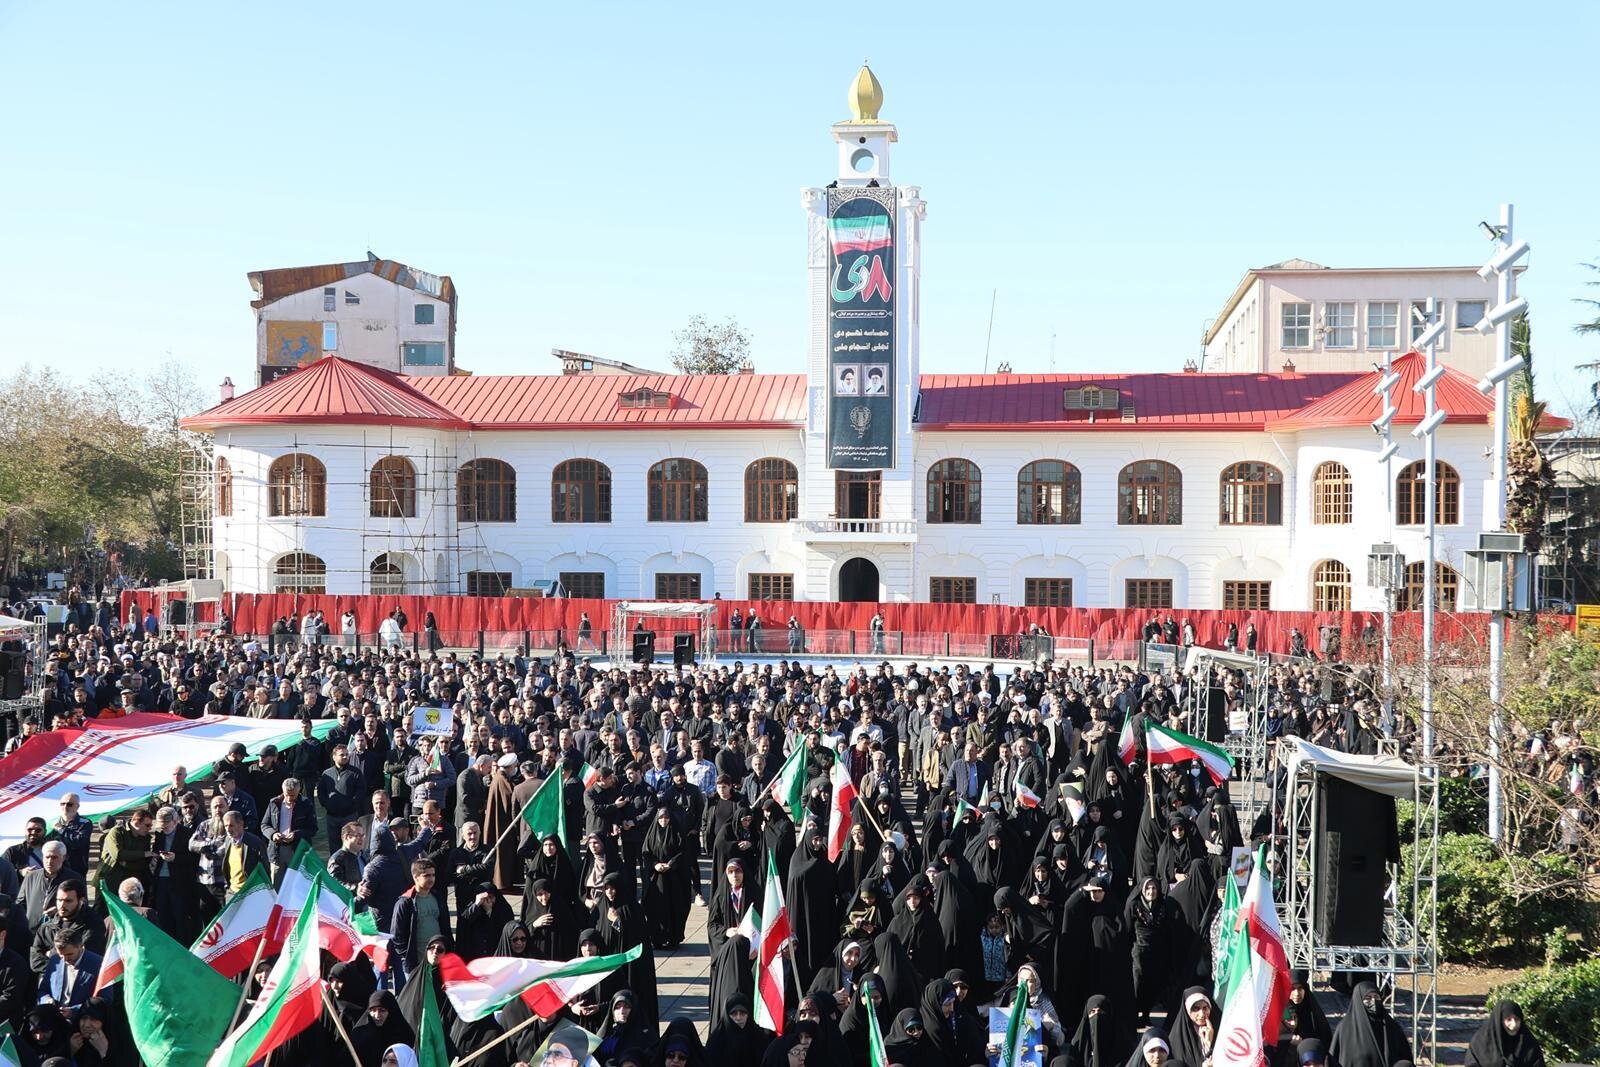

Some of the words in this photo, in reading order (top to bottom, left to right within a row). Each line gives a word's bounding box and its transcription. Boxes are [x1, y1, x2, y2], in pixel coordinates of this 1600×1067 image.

[833, 329, 845, 338] دی
[863, 328, 889, 337] حماسه
[833, 342, 848, 352] ملی
[848, 342, 871, 352] انسجام
[871, 342, 890, 352] تجلی
